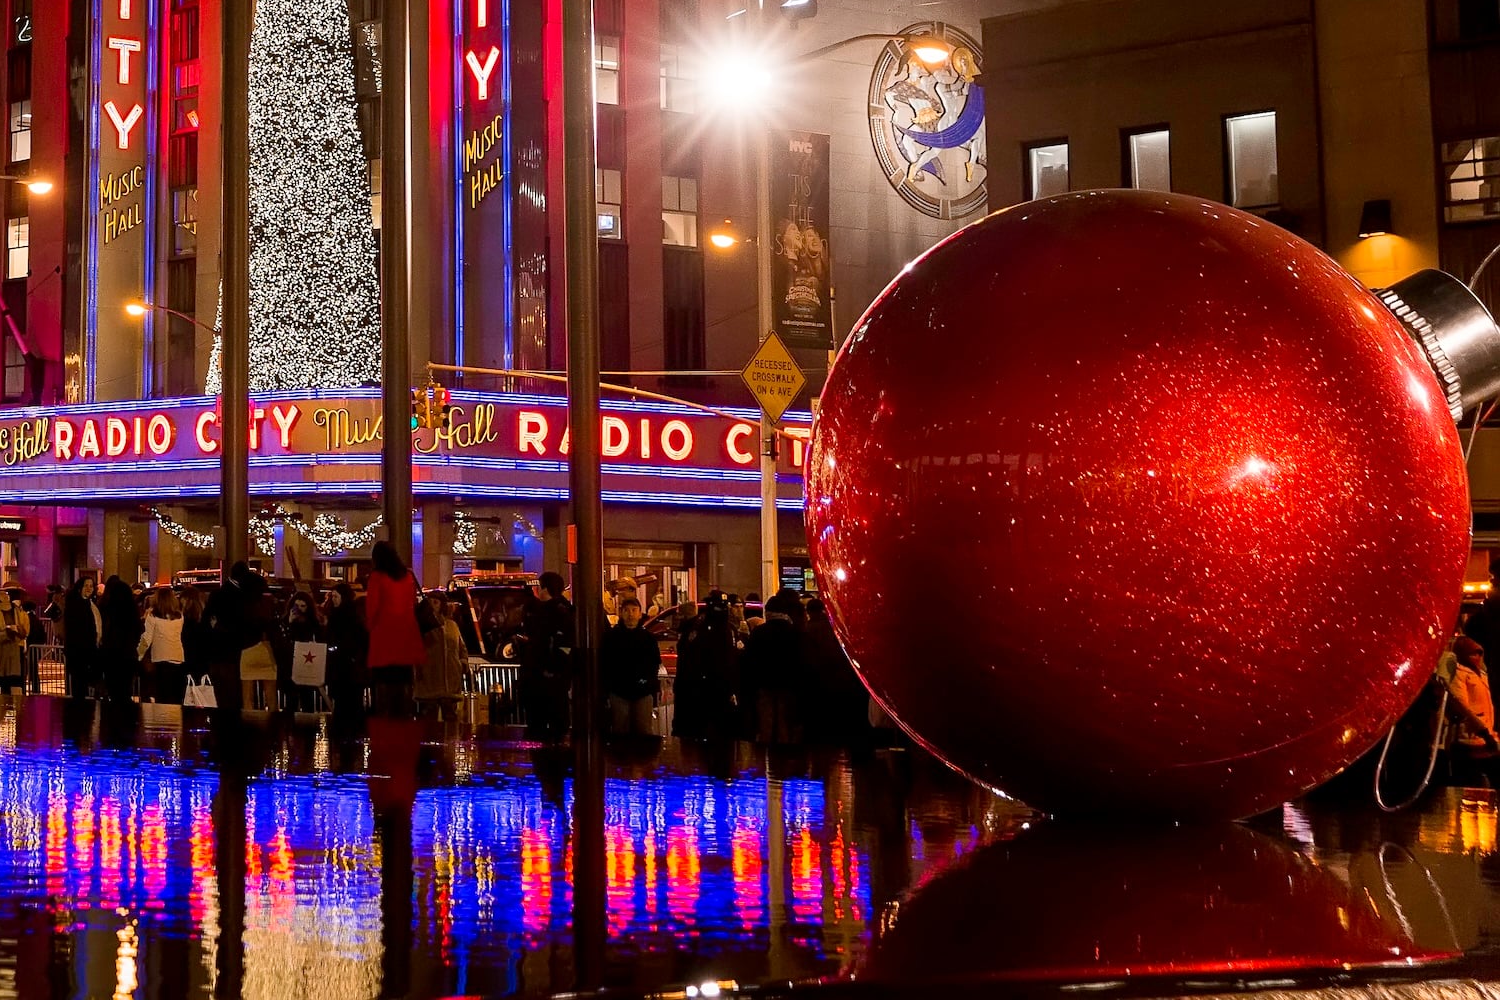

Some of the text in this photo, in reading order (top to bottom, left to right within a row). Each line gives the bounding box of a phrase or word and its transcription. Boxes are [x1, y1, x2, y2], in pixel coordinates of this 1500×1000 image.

[465, 115, 503, 173] MUSIC
[789, 140, 813, 153] NYC
[99, 166, 143, 210] MUSIC
[471, 158, 504, 209] HALL
[104, 203, 143, 243] HALL
[788, 204, 814, 228] THE
[752, 372, 796, 384] CROSSWALK
[754, 359, 793, 371] RECESSED
[756, 384, 767, 395] ON
[777, 387, 792, 397] AVE
[4, 417, 50, 466] Hall
[55, 404, 298, 460] RADIO CTY
[413, 403, 498, 453] Hall
[518, 411, 693, 461] RDIO
